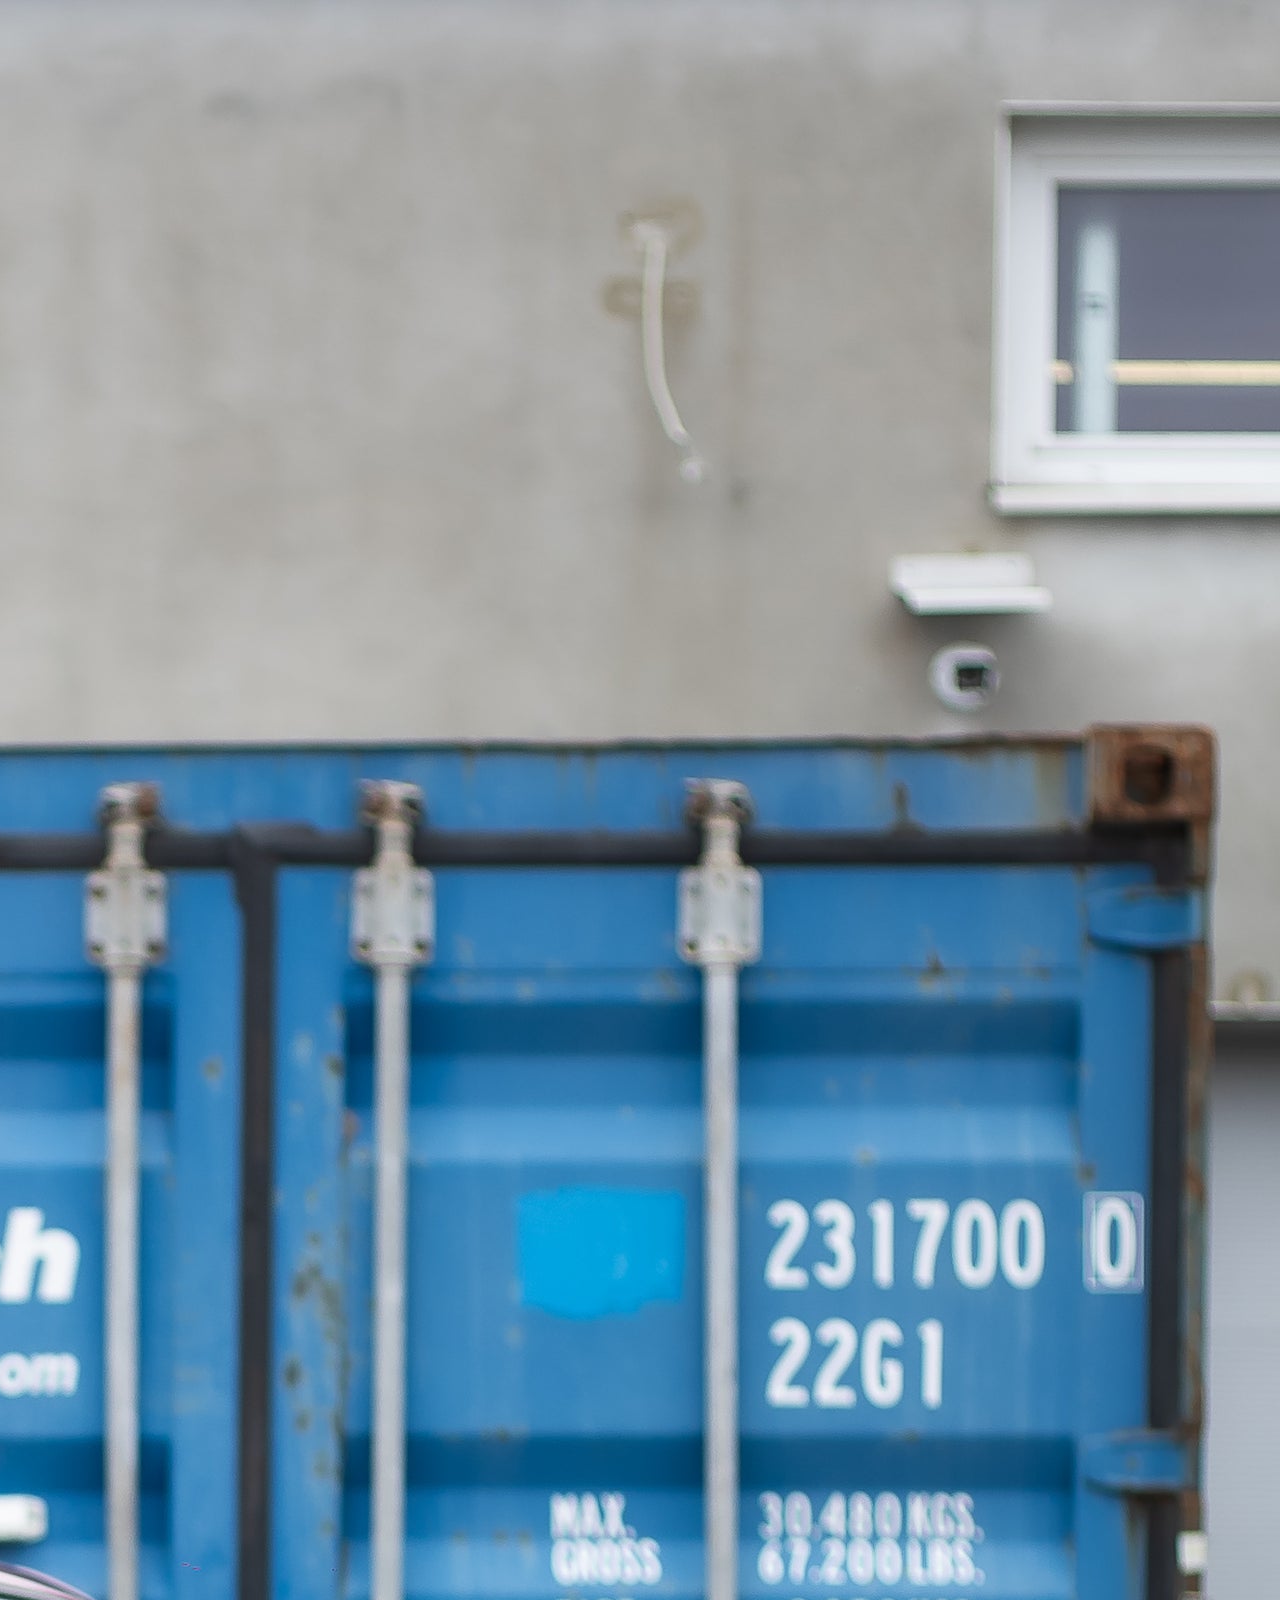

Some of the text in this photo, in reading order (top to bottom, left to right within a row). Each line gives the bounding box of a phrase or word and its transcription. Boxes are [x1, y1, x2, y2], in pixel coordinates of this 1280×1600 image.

[764, 1198, 1045, 1291] 231700
[765, 1317, 945, 1409] 22G1
[905, 1491, 985, 1540] KGS.
